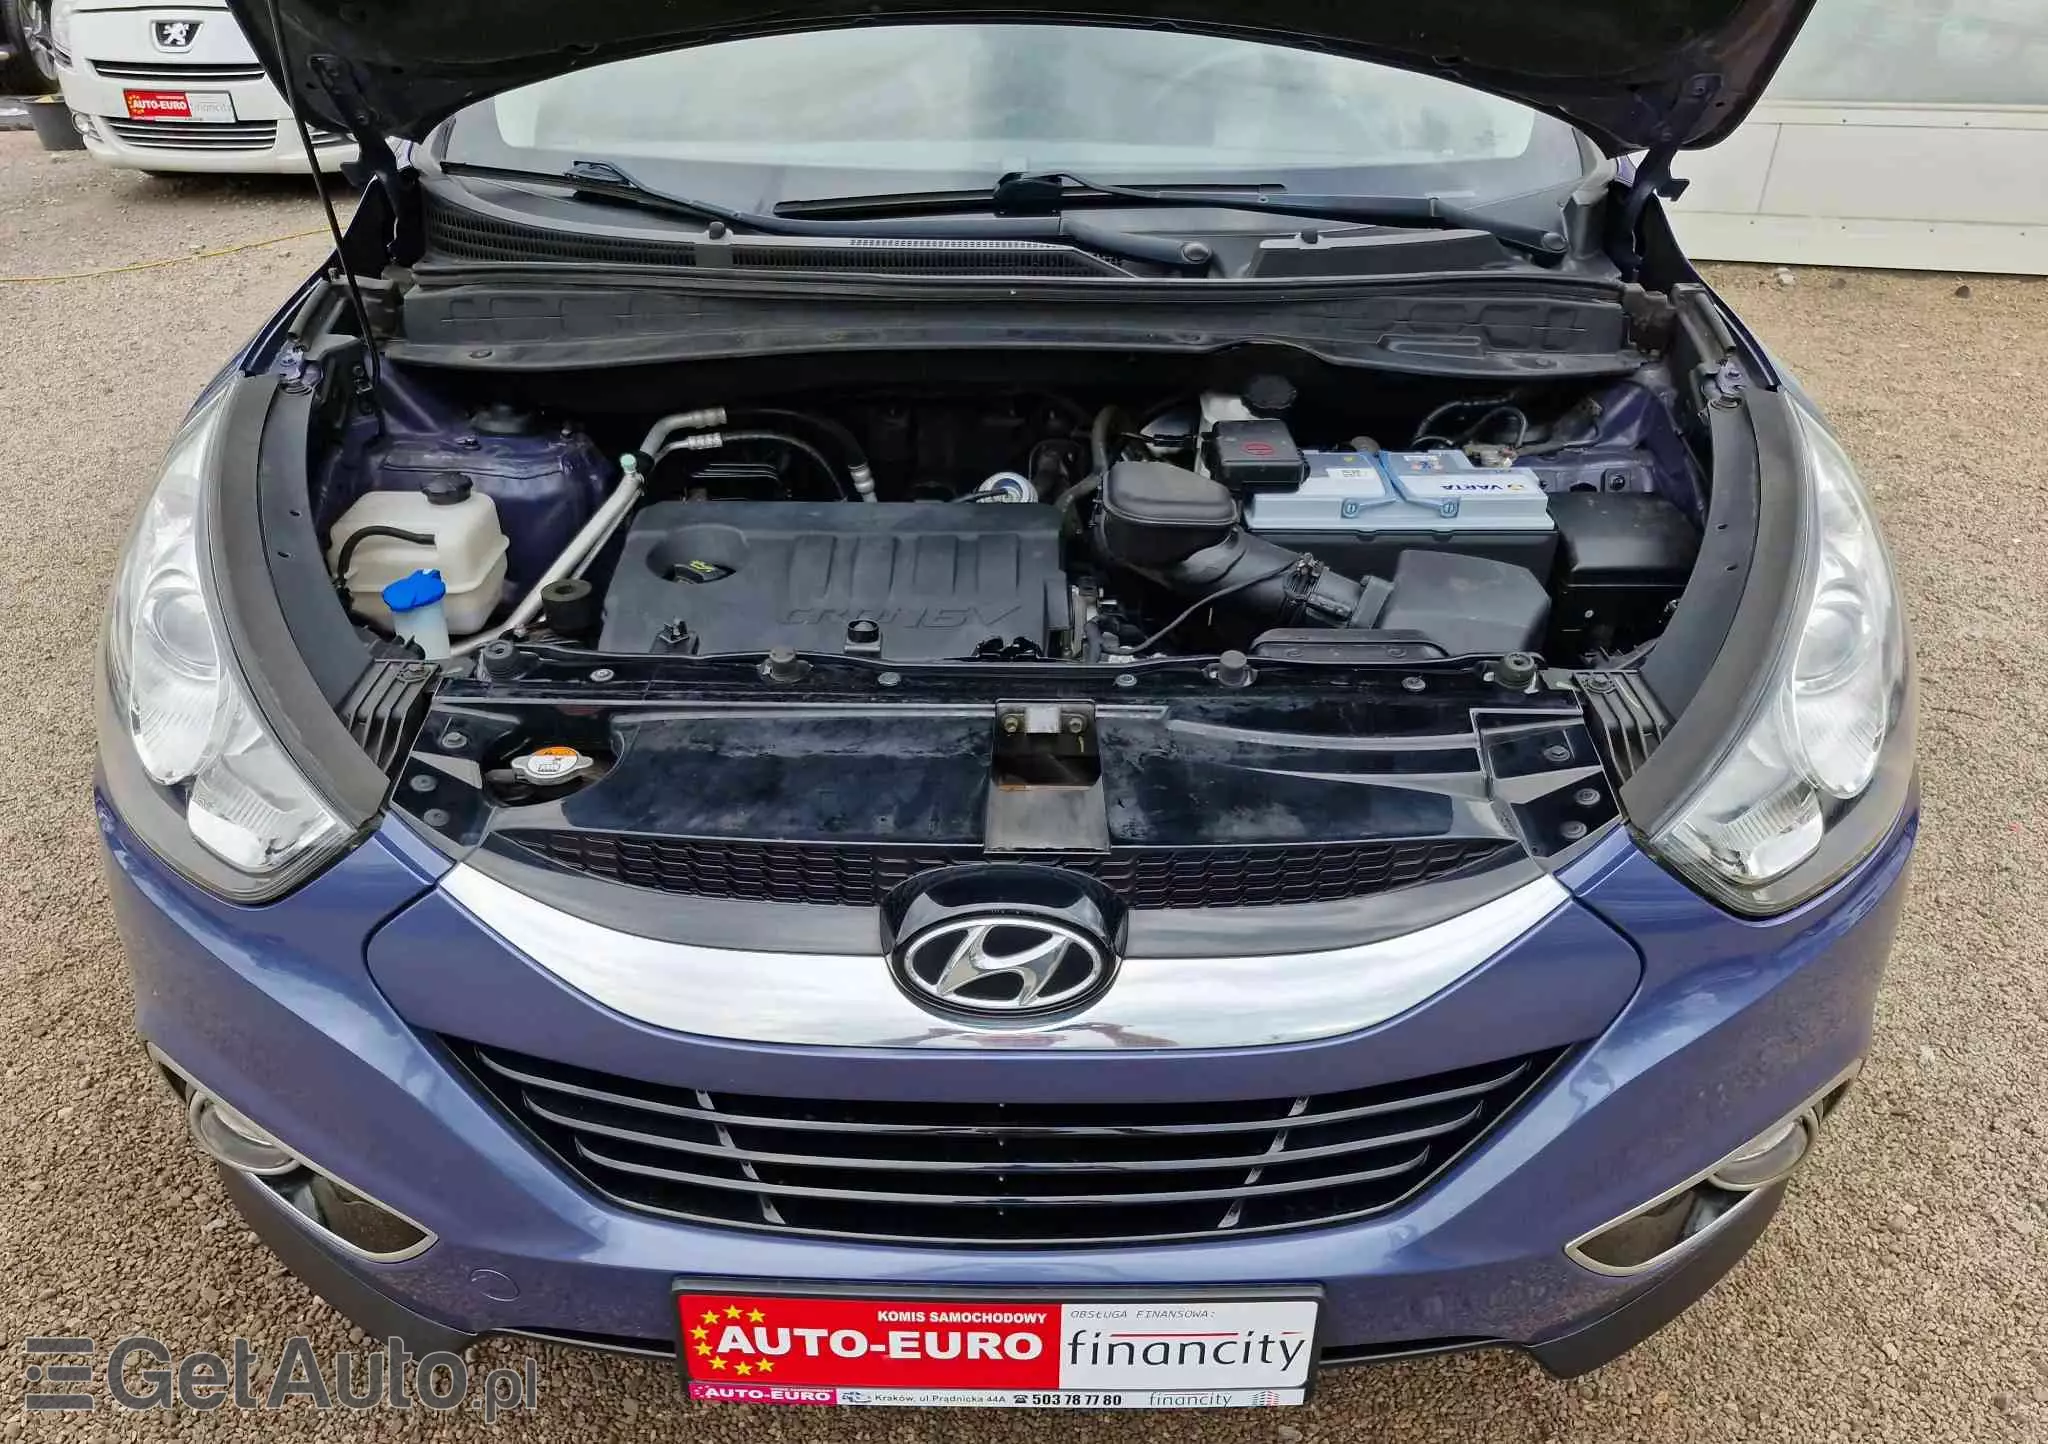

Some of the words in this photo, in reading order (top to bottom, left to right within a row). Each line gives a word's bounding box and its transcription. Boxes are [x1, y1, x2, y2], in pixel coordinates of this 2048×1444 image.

[133, 100, 187, 110] AUTO-EURO
[1440, 483, 1503, 491] VARTA
[877, 1310, 926, 1323] KOMIS
[929, 1311, 1048, 1325] SAMOCHODOWY
[716, 1325, 1043, 1361] AUTO-EURO
[1067, 1329, 1306, 1372] financity
[704, 1387, 832, 1401] AUTO-EURO
[986, 1395, 1006, 1404] 44A
[1032, 1393, 1061, 1406] 503
[1064, 1393, 1081, 1406] 78
[1085, 1394, 1100, 1406] 77
[1102, 1394, 1122, 1406] 80
[1149, 1391, 1232, 1408] financity
